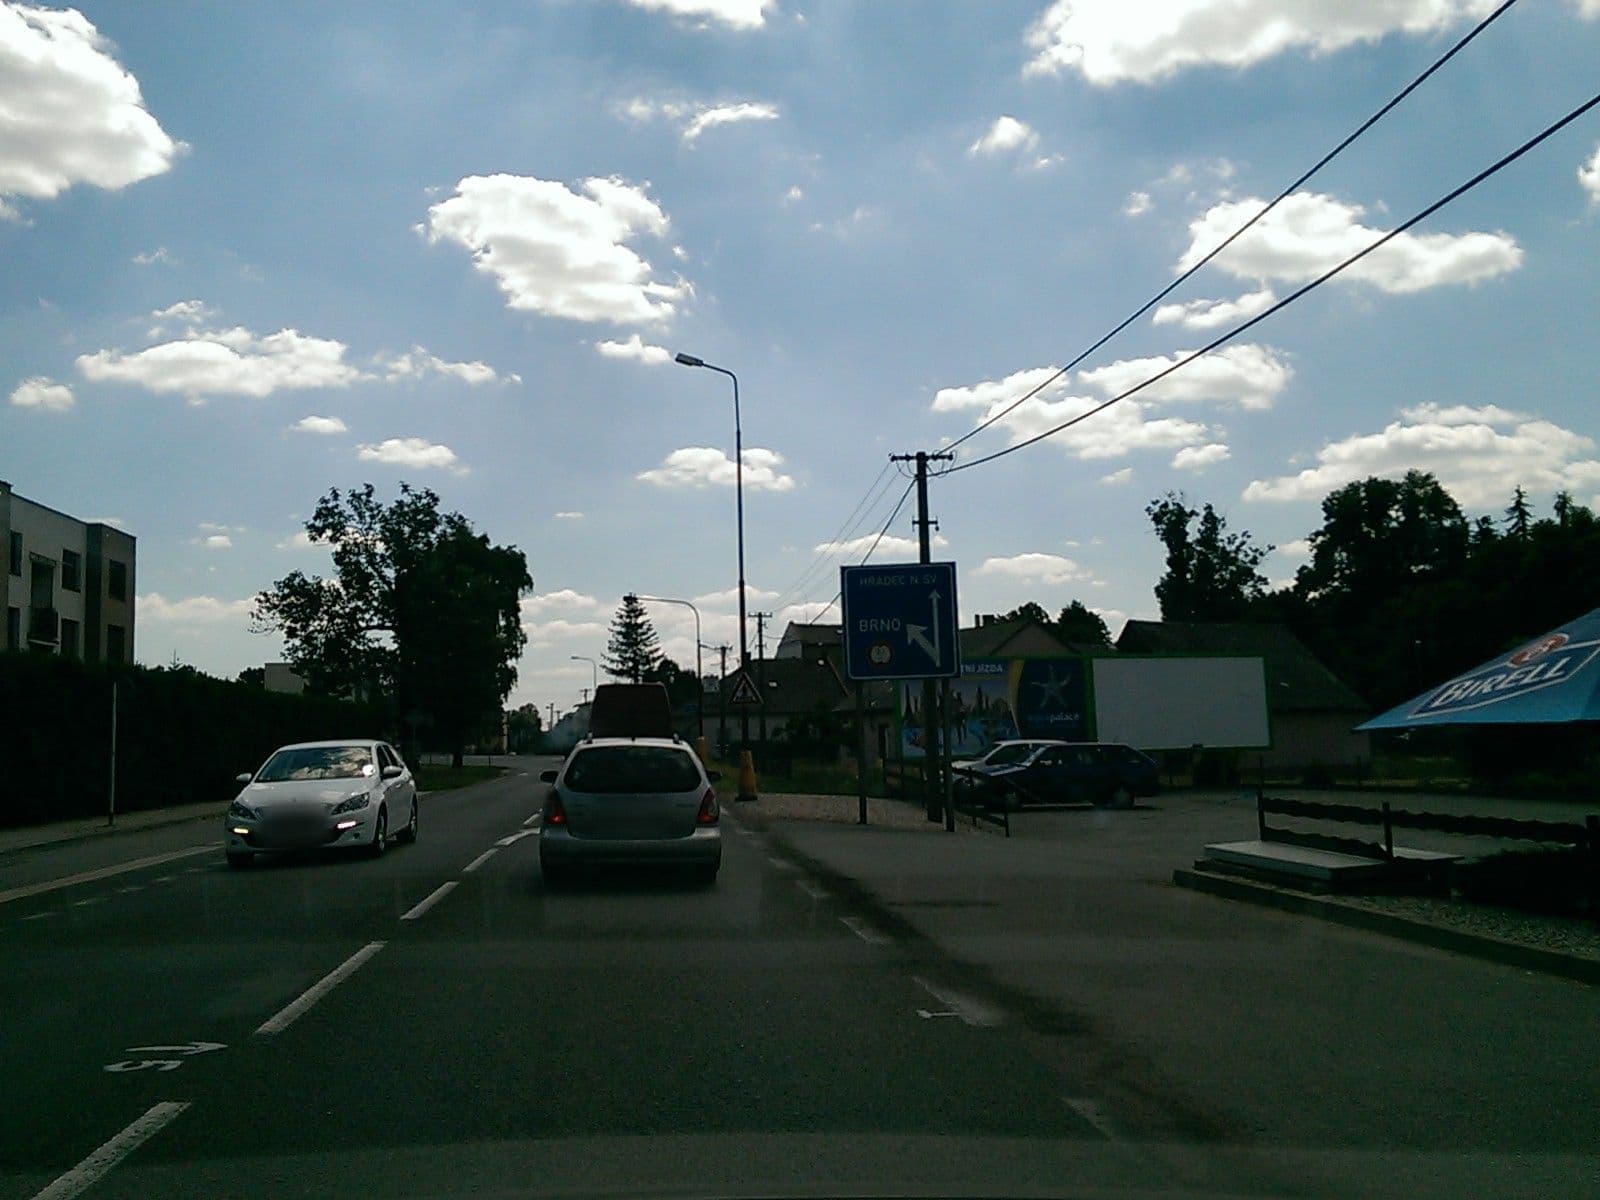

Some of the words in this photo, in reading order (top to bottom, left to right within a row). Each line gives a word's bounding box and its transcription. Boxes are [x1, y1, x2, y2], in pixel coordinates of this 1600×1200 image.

[859, 575, 905, 587] HRADEC
[858, 618, 901, 632] BRNO
[1429, 655, 1574, 708] BIRELL
